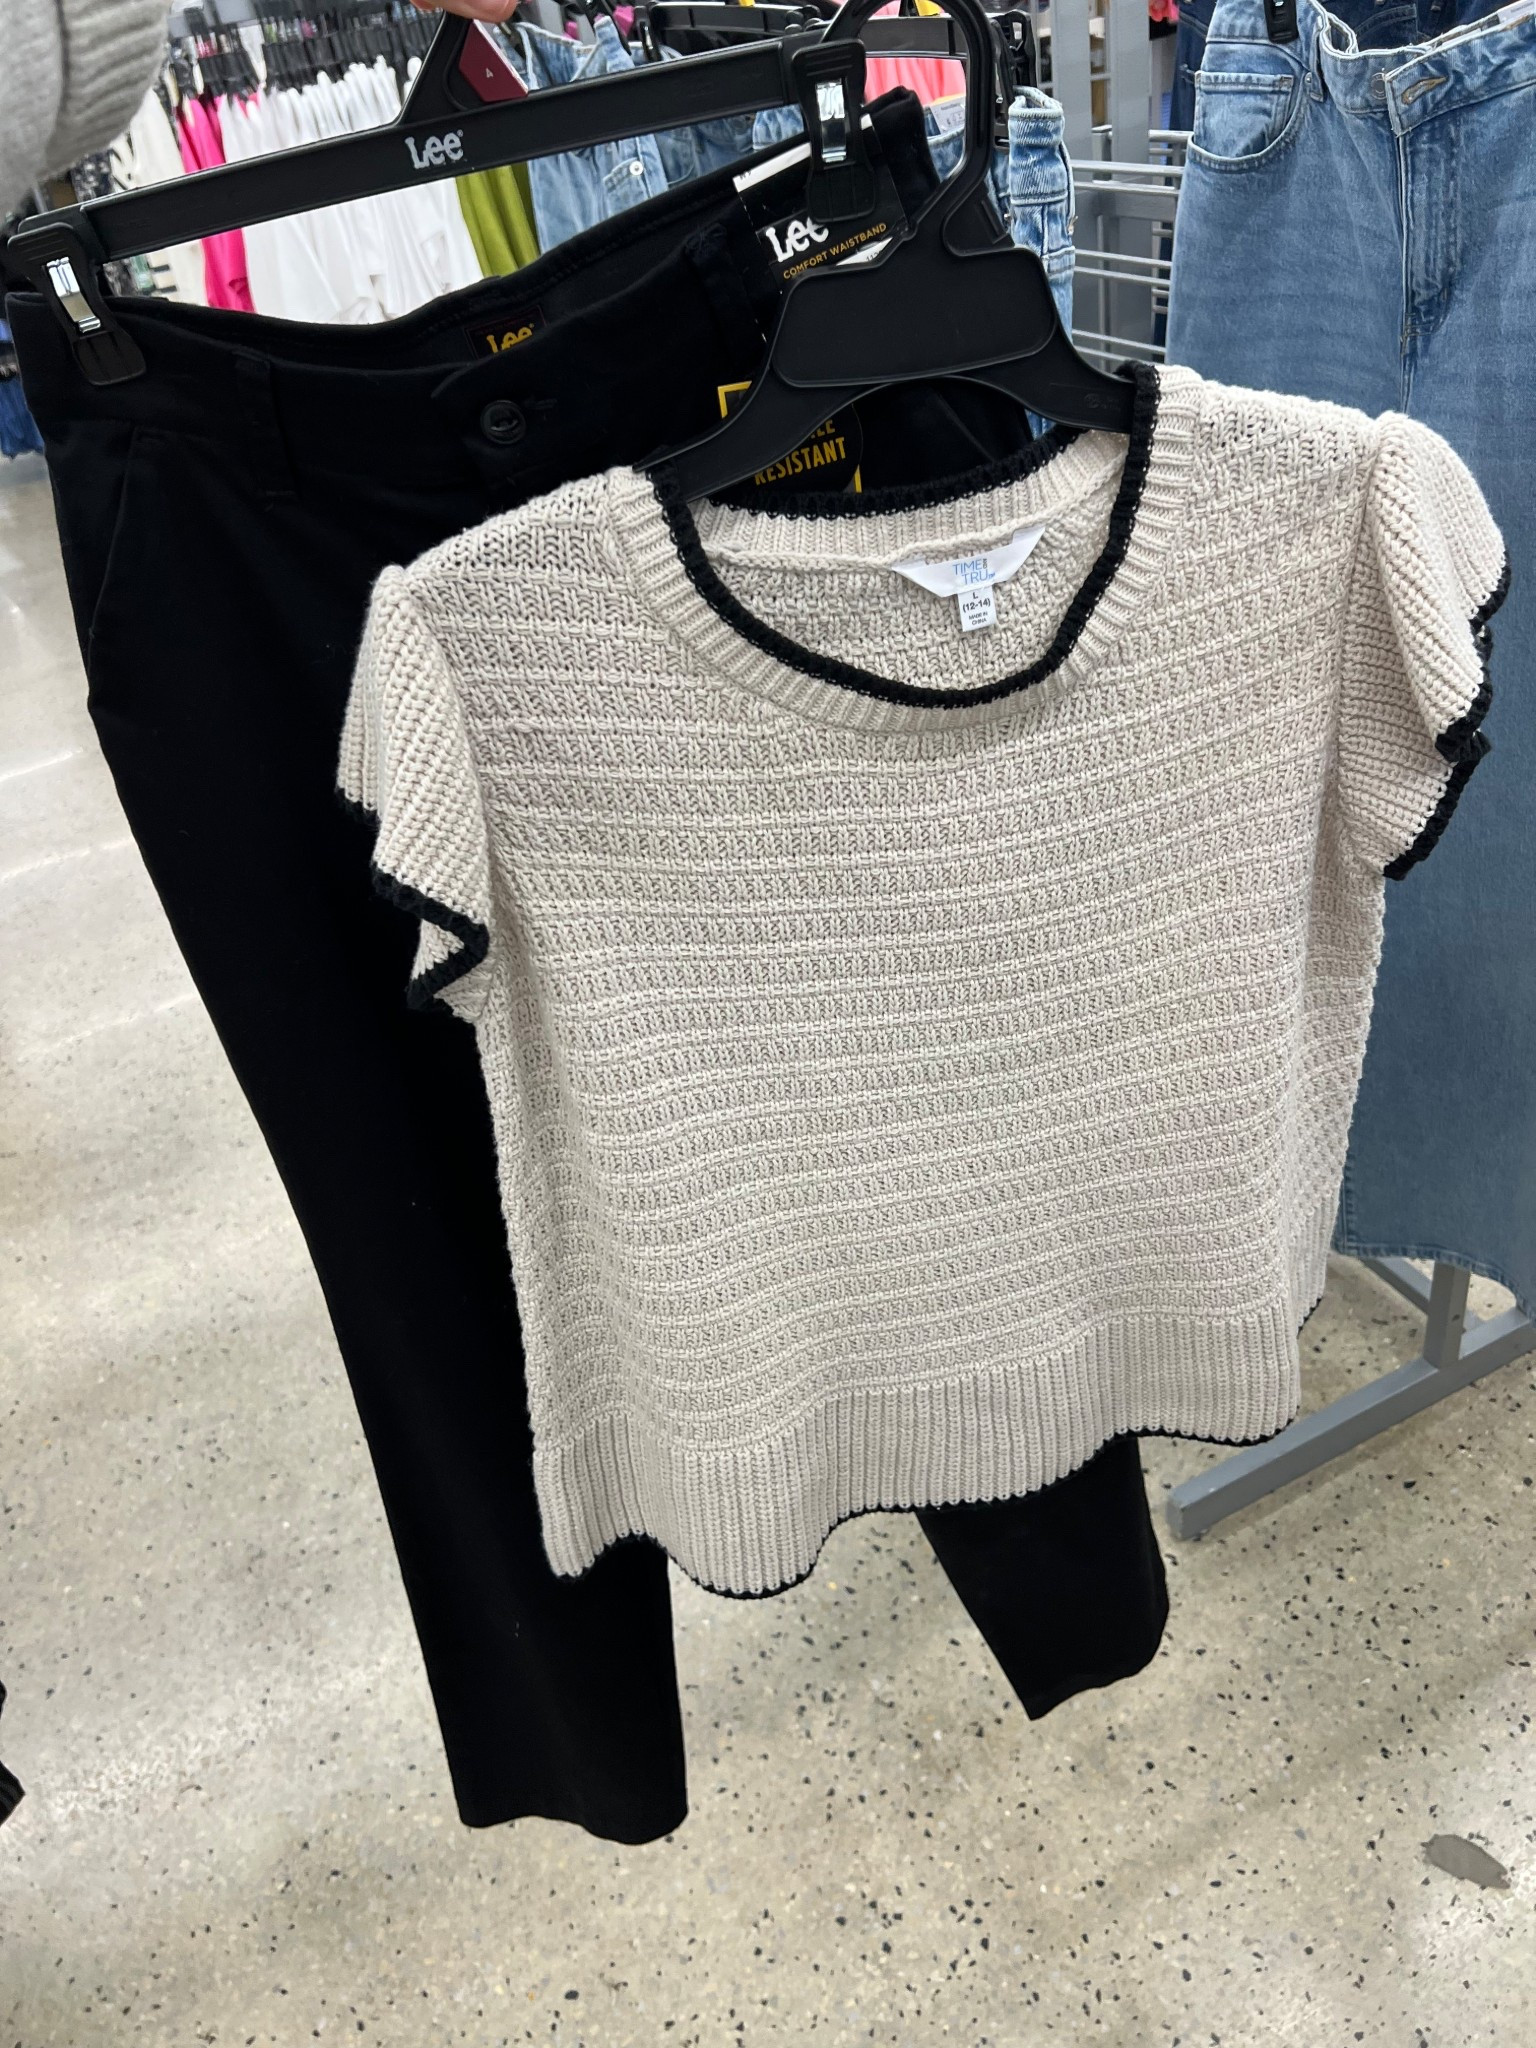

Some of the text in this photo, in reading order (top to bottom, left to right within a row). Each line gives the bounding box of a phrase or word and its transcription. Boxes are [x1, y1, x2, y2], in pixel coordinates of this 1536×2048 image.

[404, 131, 464, 170] Lee
[783, 222, 887, 280] COMFORT WAISTBAND
[754, 436, 847, 486] RESISTANT
[952, 559, 982, 576] TIME
[962, 570, 988, 585] TRU
[962, 598, 991, 613] (12-14)
